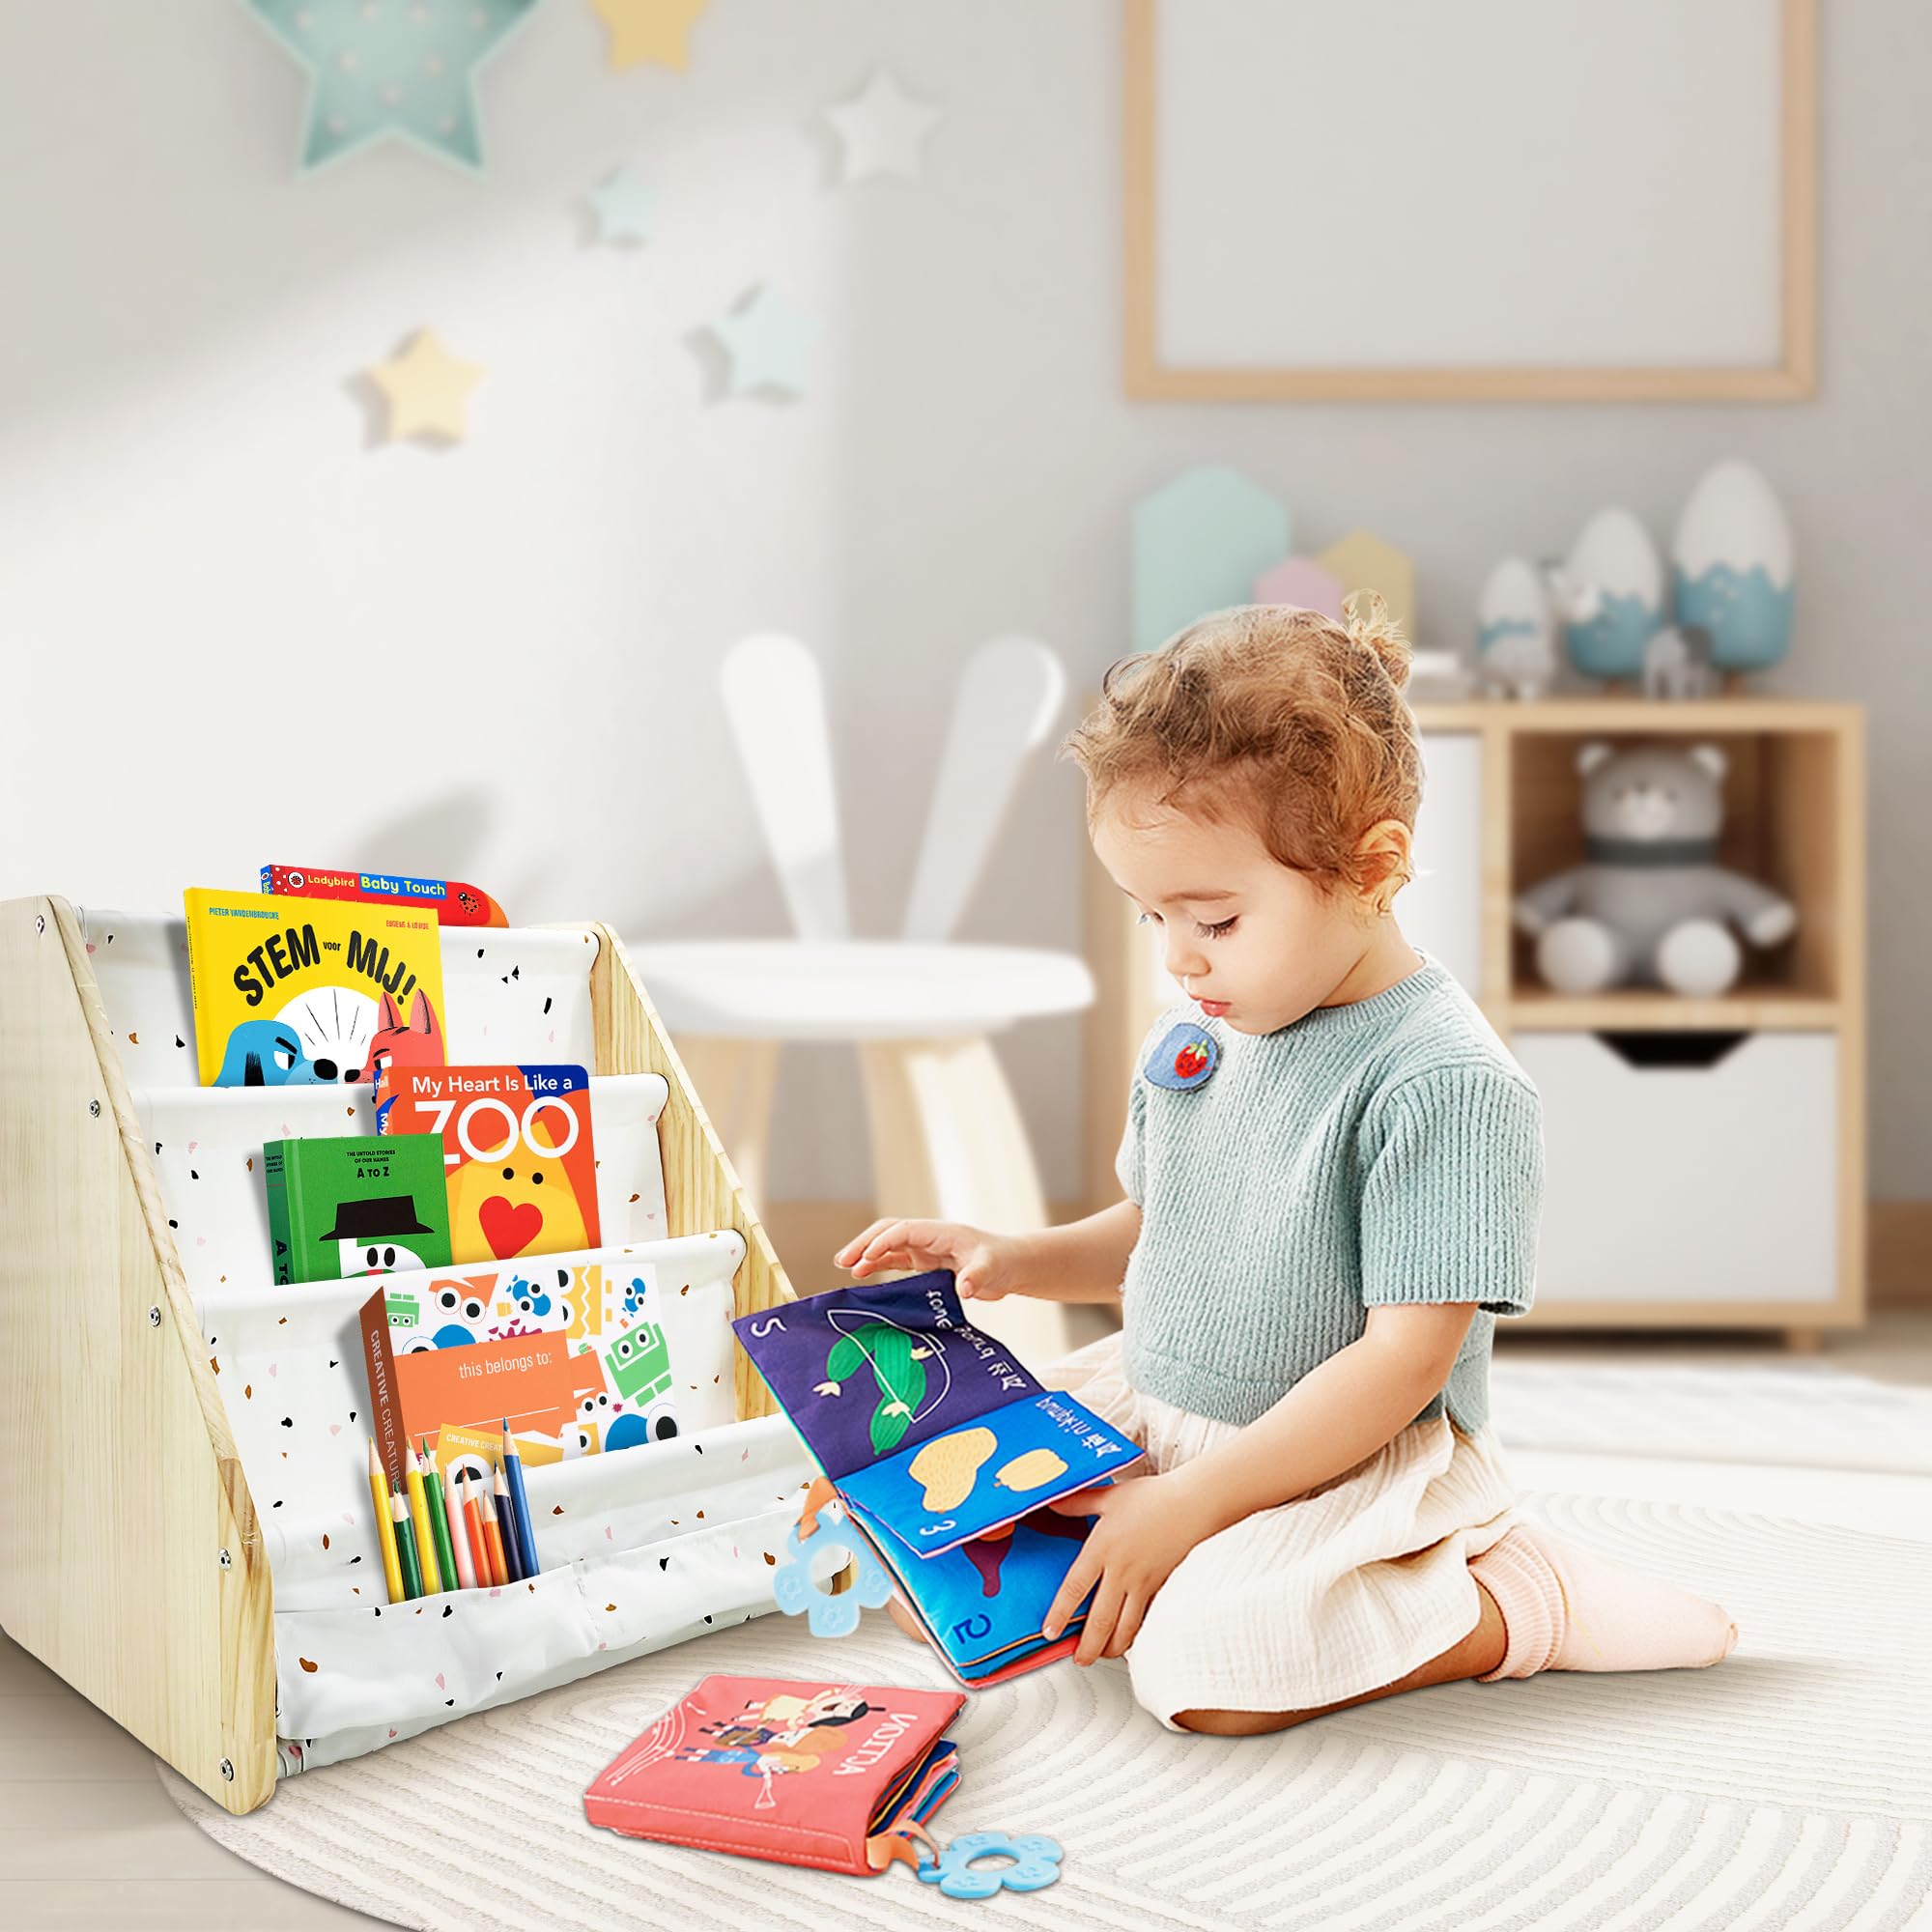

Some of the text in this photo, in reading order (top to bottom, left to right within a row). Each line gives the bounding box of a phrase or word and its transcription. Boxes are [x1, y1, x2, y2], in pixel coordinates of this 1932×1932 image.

[308, 875, 355, 887] Ladybird
[361, 876, 445, 895] Baby Touch
[234, 923, 321, 1007] STEM
[323, 941, 341, 952] voor
[347, 930, 416, 1006] MIJ!
[412, 1073, 573, 1097] My Heart Is Like a
[414, 1095, 579, 1164] ZOO
[357, 1167, 389, 1178] A TO Z
[275, 1239, 287, 1257] A
[370, 1329, 389, 1407] CREATIVE
[459, 1352, 552, 1378] this belongs to:
[446, 1434, 503, 1452] CREATIVE CREAT
